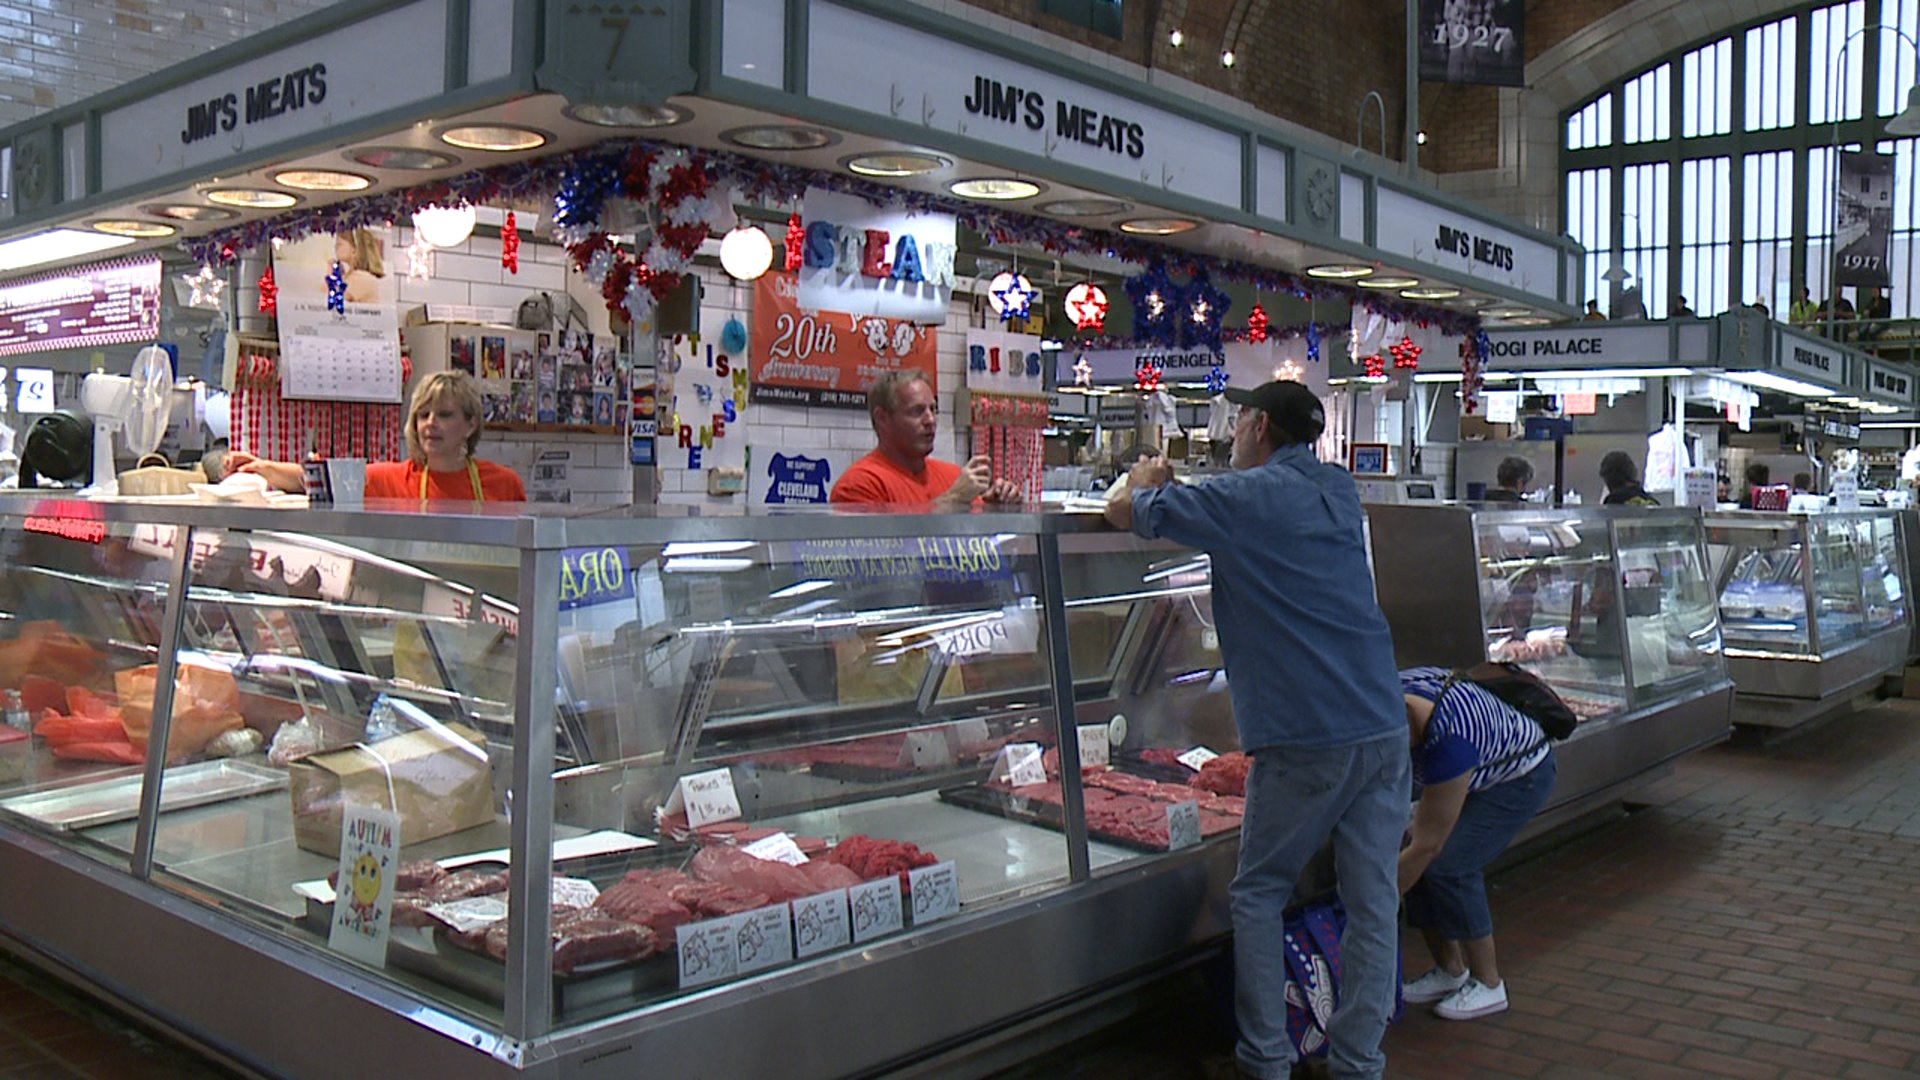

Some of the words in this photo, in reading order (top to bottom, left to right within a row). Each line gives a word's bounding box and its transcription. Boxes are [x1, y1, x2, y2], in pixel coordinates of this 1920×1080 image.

[1433, 23, 1511, 53] 1927
[181, 92, 238, 144] JIM'S
[245, 62, 327, 125] MEATS
[964, 75, 1045, 131] JIM'S
[1056, 100, 1145, 159] MEATS
[804, 220, 958, 289] STEAK
[1435, 224, 1470, 258] JIM'S
[1473, 235, 1514, 272] MEATS
[1843, 254, 1881, 271] 1917
[769, 312, 837, 360] 20th
[1533, 338, 1603, 356] PALACE
[757, 355, 841, 389] Anniversary
[969, 345, 1041, 377] RIBS
[777, 481, 820, 499] CLEVELAND
